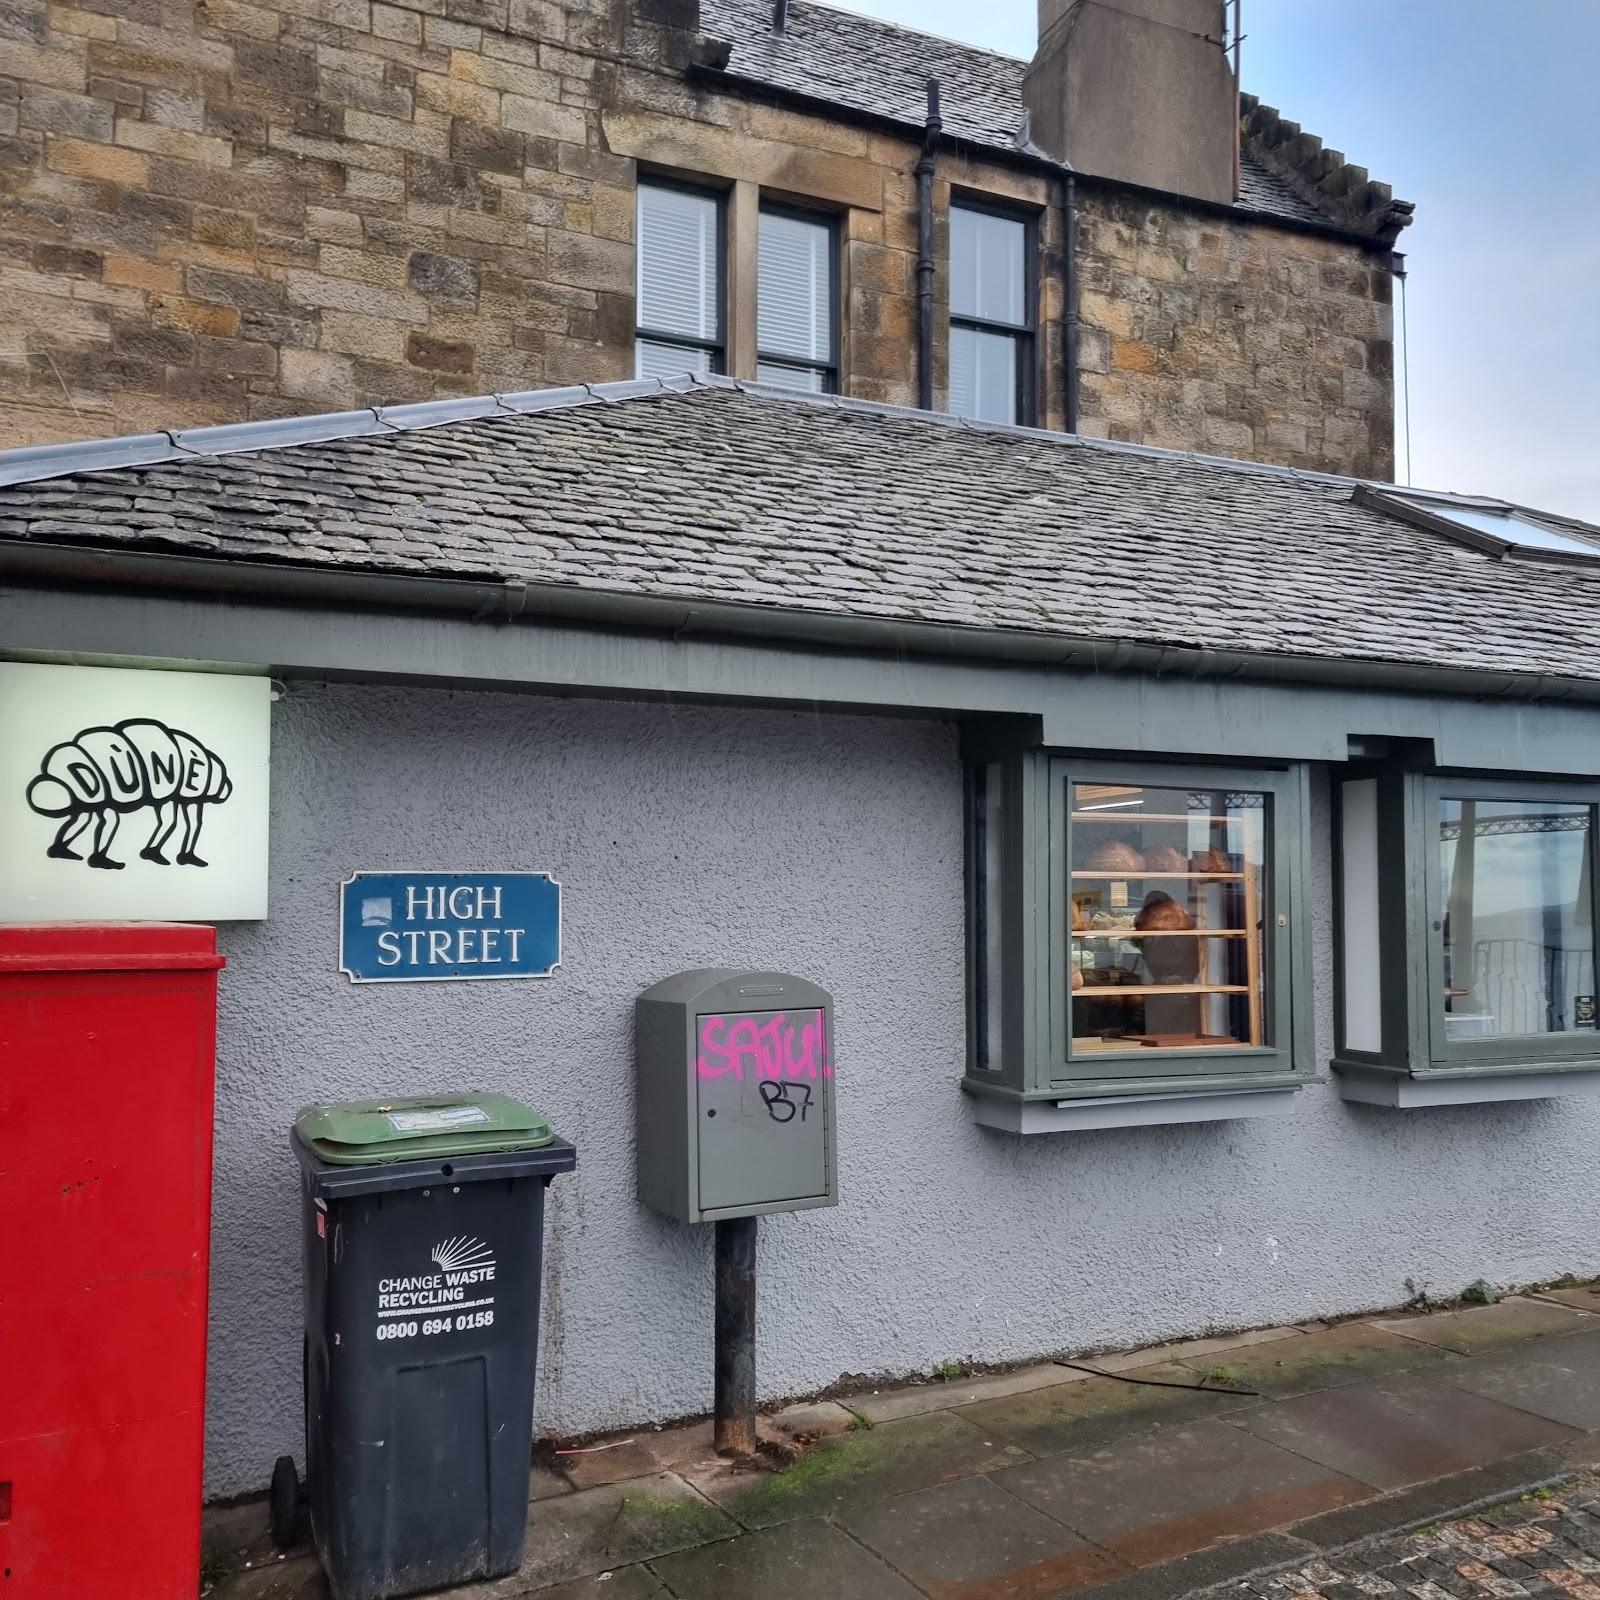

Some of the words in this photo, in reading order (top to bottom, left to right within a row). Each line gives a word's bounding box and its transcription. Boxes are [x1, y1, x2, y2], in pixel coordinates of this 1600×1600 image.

[406, 886, 502, 920] HIGH
[378, 929, 525, 966] STREET
[378, 1274, 442, 1293] CHANGE
[445, 1267, 496, 1286] WASTE
[378, 1287, 464, 1308] RECYCLING
[376, 1321, 418, 1341] 0800
[422, 1317, 452, 1335] 694
[456, 1310, 494, 1331] 0158
